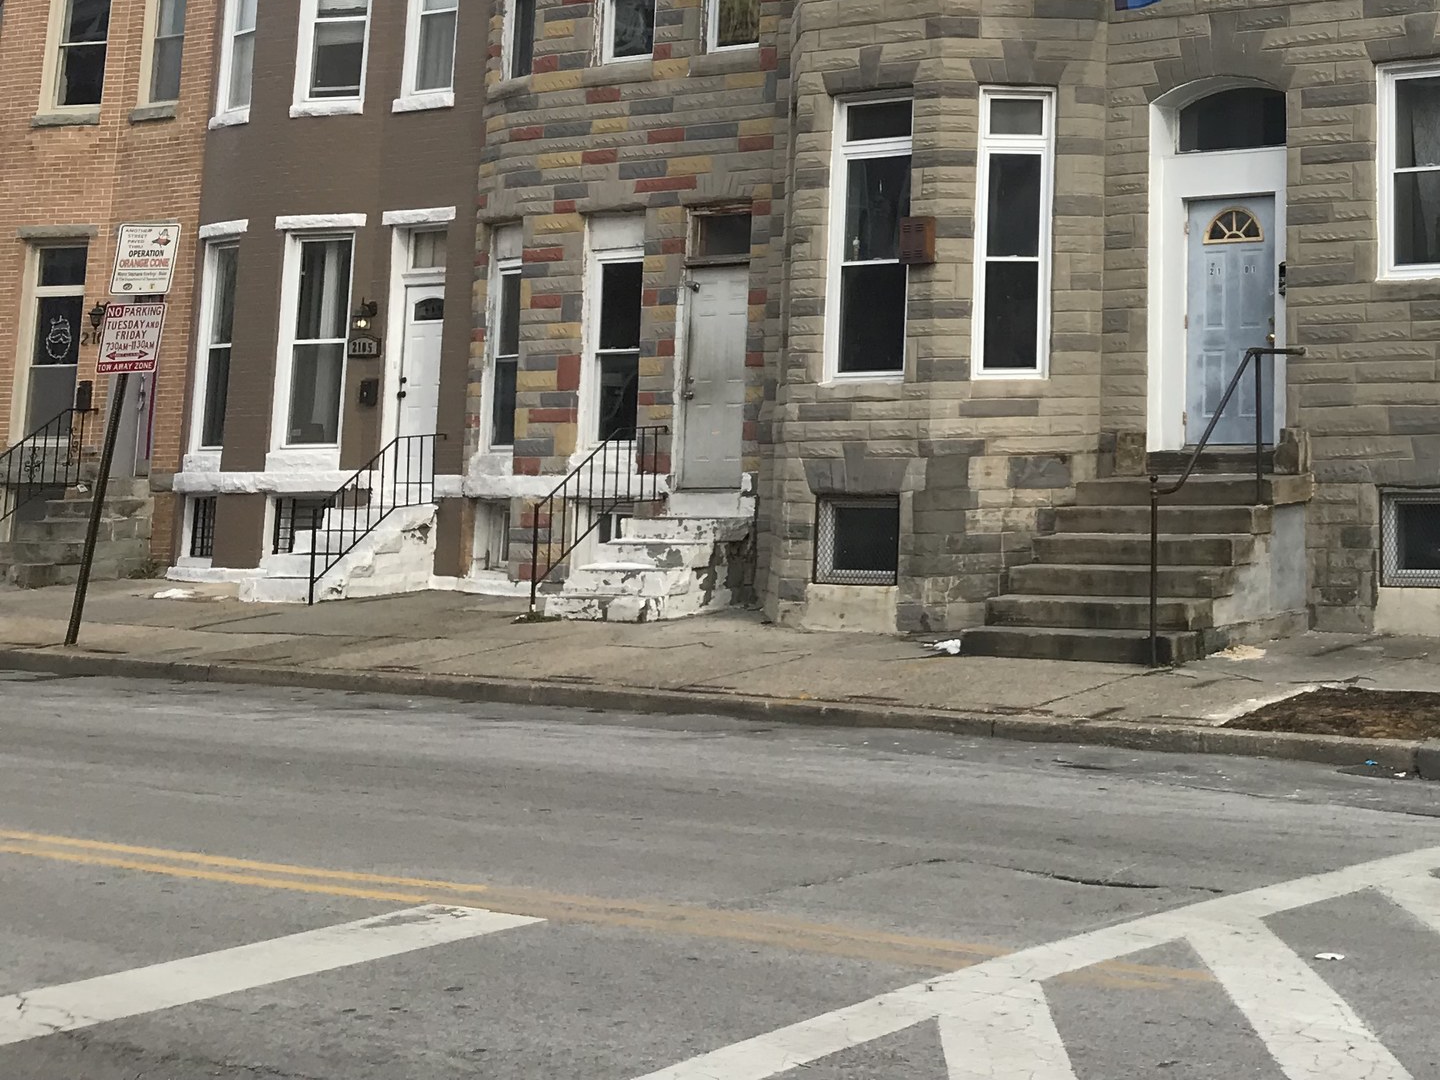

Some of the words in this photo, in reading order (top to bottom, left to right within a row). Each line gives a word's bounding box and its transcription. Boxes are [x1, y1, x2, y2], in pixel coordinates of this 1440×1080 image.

[119, 258, 149, 268] ORANGE
[150, 258, 170, 268] CONE
[107, 307, 122, 317] NO
[124, 306, 162, 317] PARKING
[107, 320, 146, 330] TUESDAY
[145, 321, 159, 329] AND
[115, 330, 147, 340] FRIDAY
[352, 341, 373, 353] 2105
[113, 363, 134, 371] AWAY
[134, 362, 153, 370] ZONE
